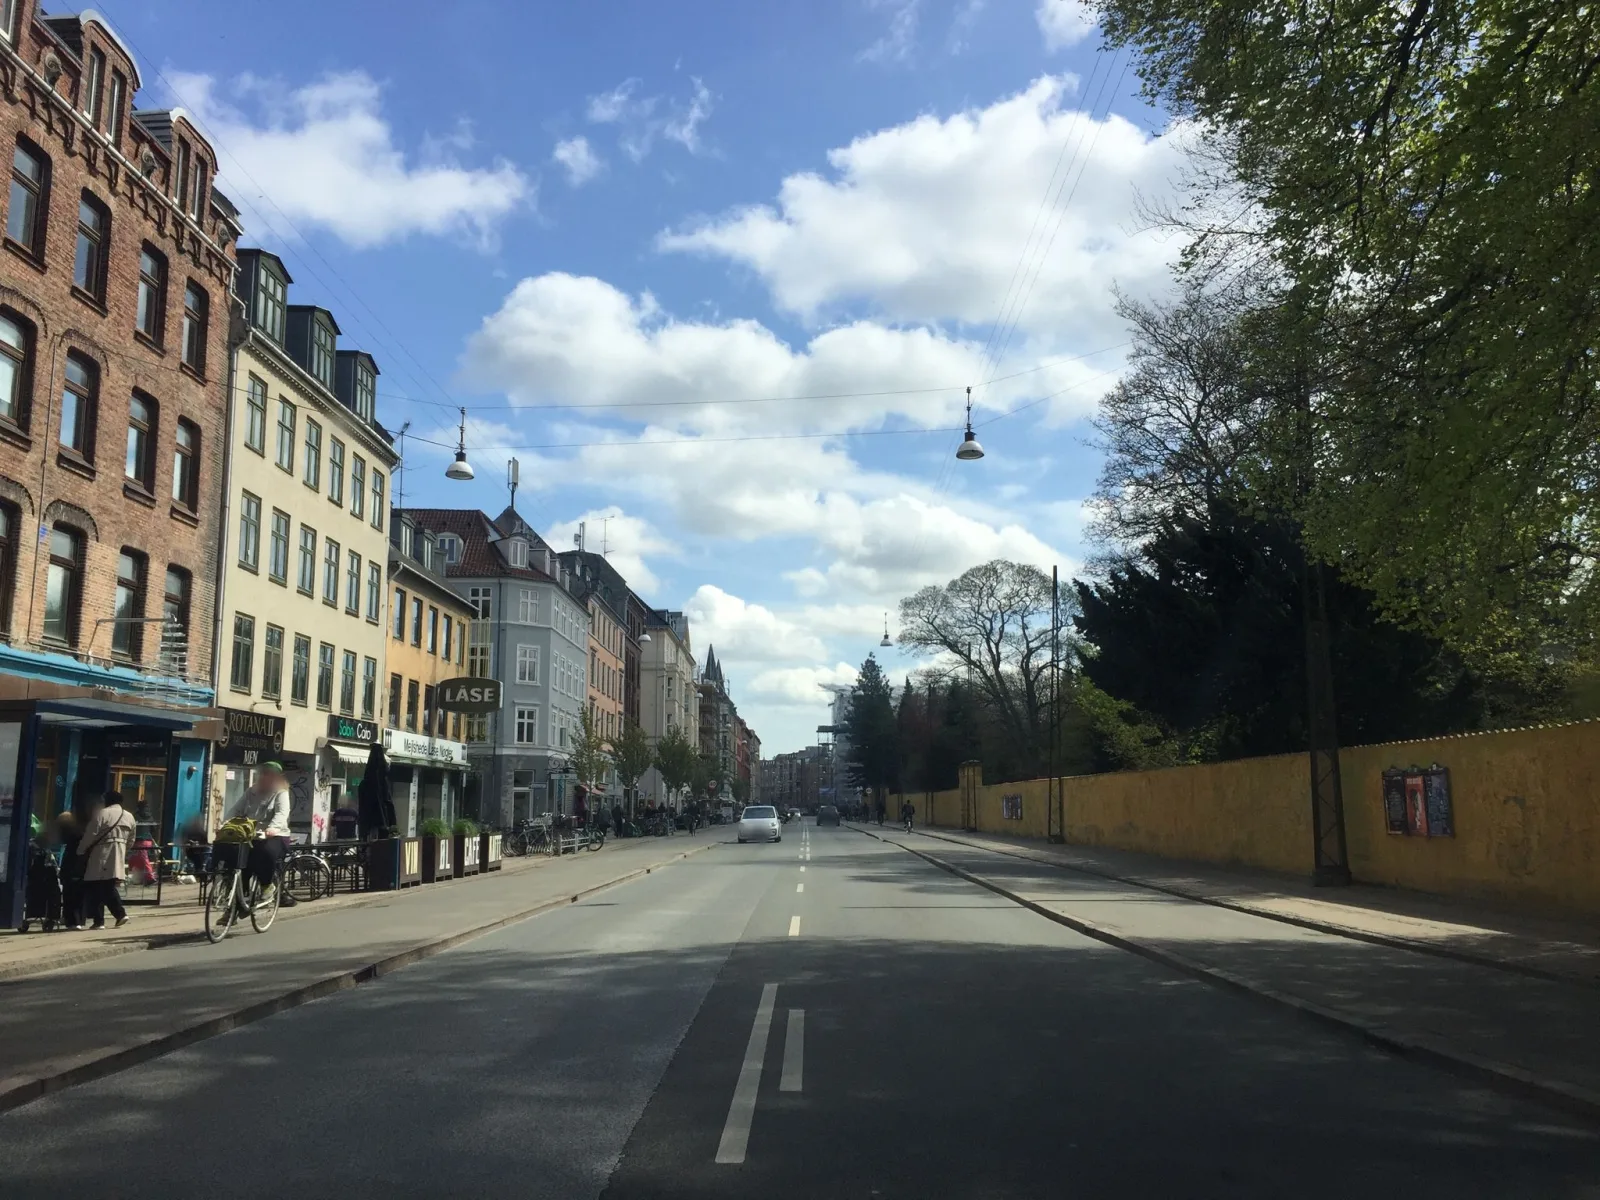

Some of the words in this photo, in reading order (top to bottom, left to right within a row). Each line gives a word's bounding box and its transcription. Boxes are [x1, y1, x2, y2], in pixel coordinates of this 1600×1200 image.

[445, 684, 495, 703] LÅSE
[229, 712, 267, 736] ROTANA
[243, 750, 258, 765] MEN
